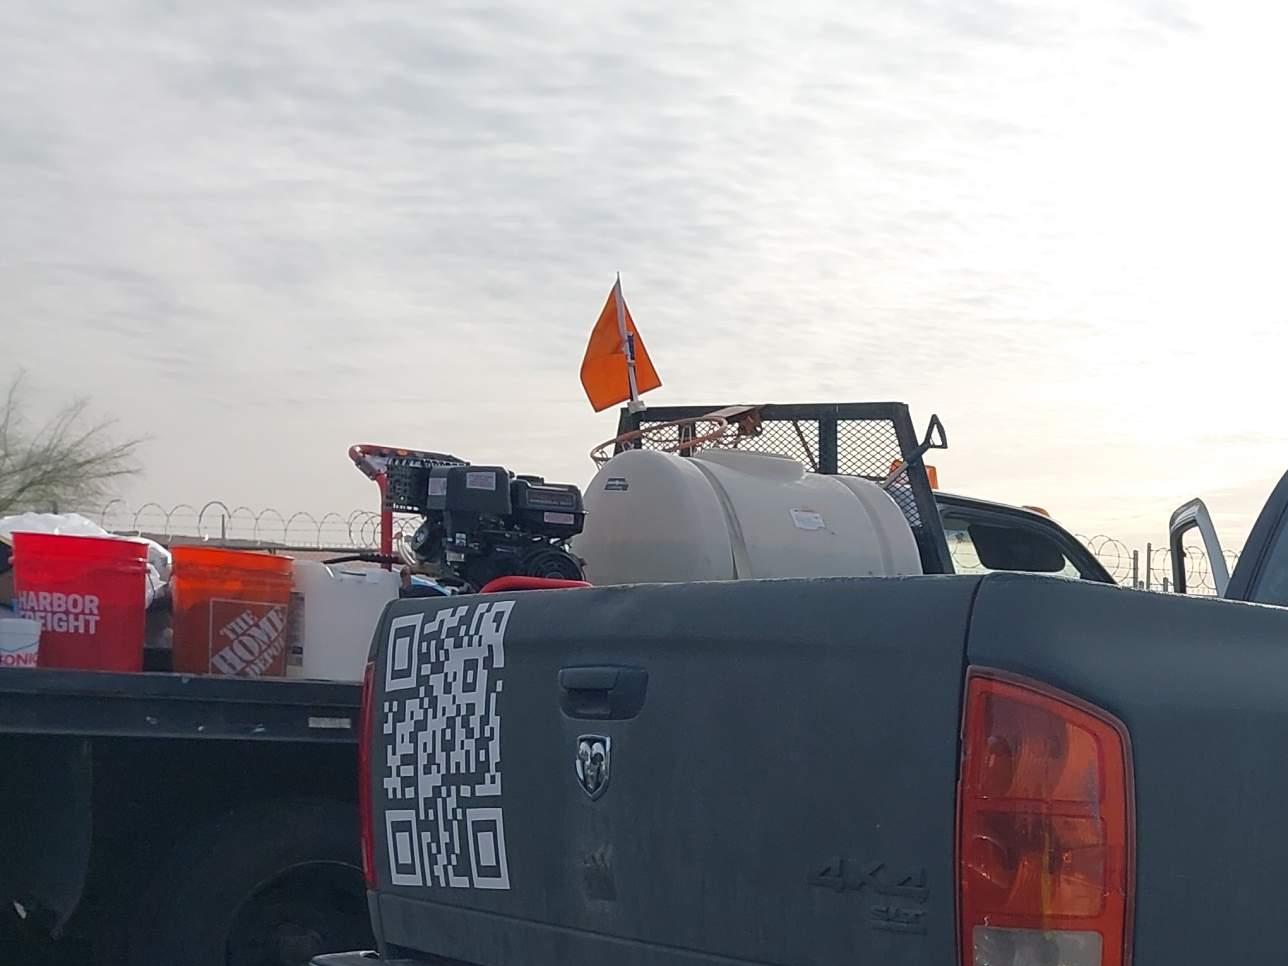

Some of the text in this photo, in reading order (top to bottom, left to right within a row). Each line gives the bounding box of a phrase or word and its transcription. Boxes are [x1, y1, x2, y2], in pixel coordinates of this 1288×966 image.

[18, 591, 100, 614] HARBOR
[211, 606, 284, 675] HOME
[219, 609, 259, 641] THE
